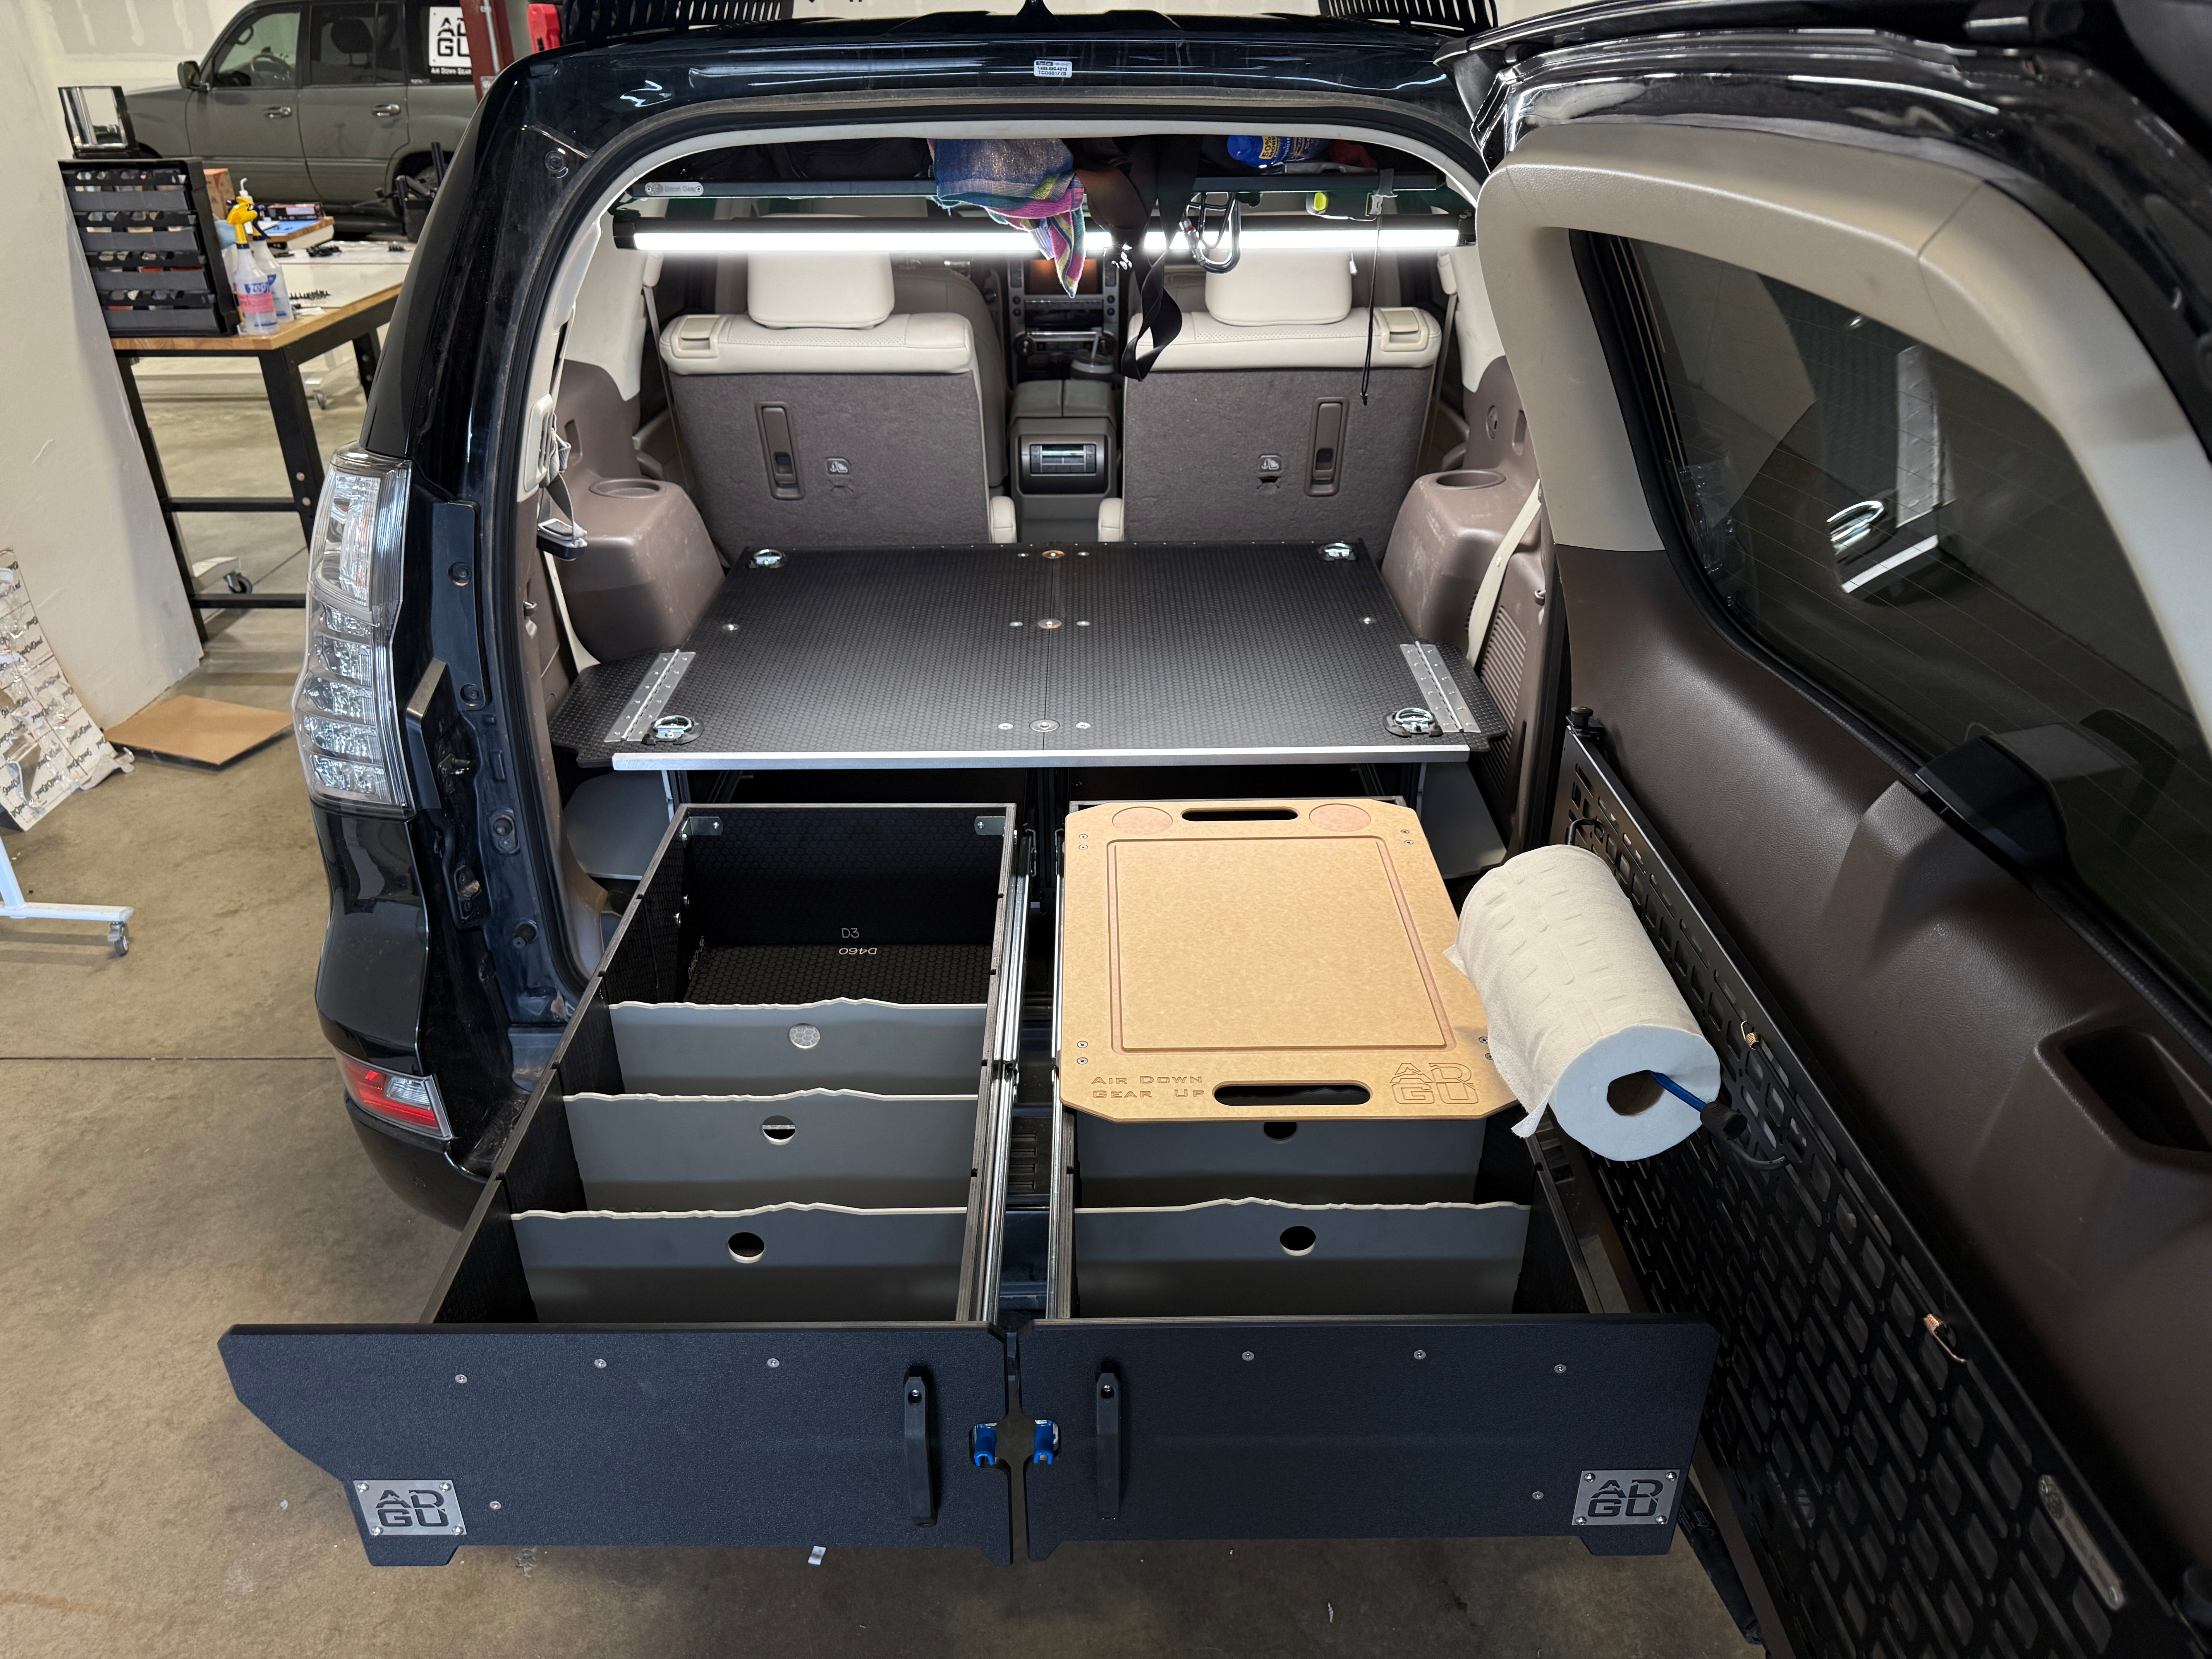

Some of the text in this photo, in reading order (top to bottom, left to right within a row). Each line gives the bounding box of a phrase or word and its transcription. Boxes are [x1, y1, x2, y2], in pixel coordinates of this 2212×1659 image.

[841, 927, 860, 939] D3
[1174, 1089, 1205, 1097] UP
[1590, 1479, 1664, 1498] AD
[375, 1489, 445, 1508] AD
[1587, 1498, 1659, 1517] GU
[377, 1508, 449, 1527] GU
